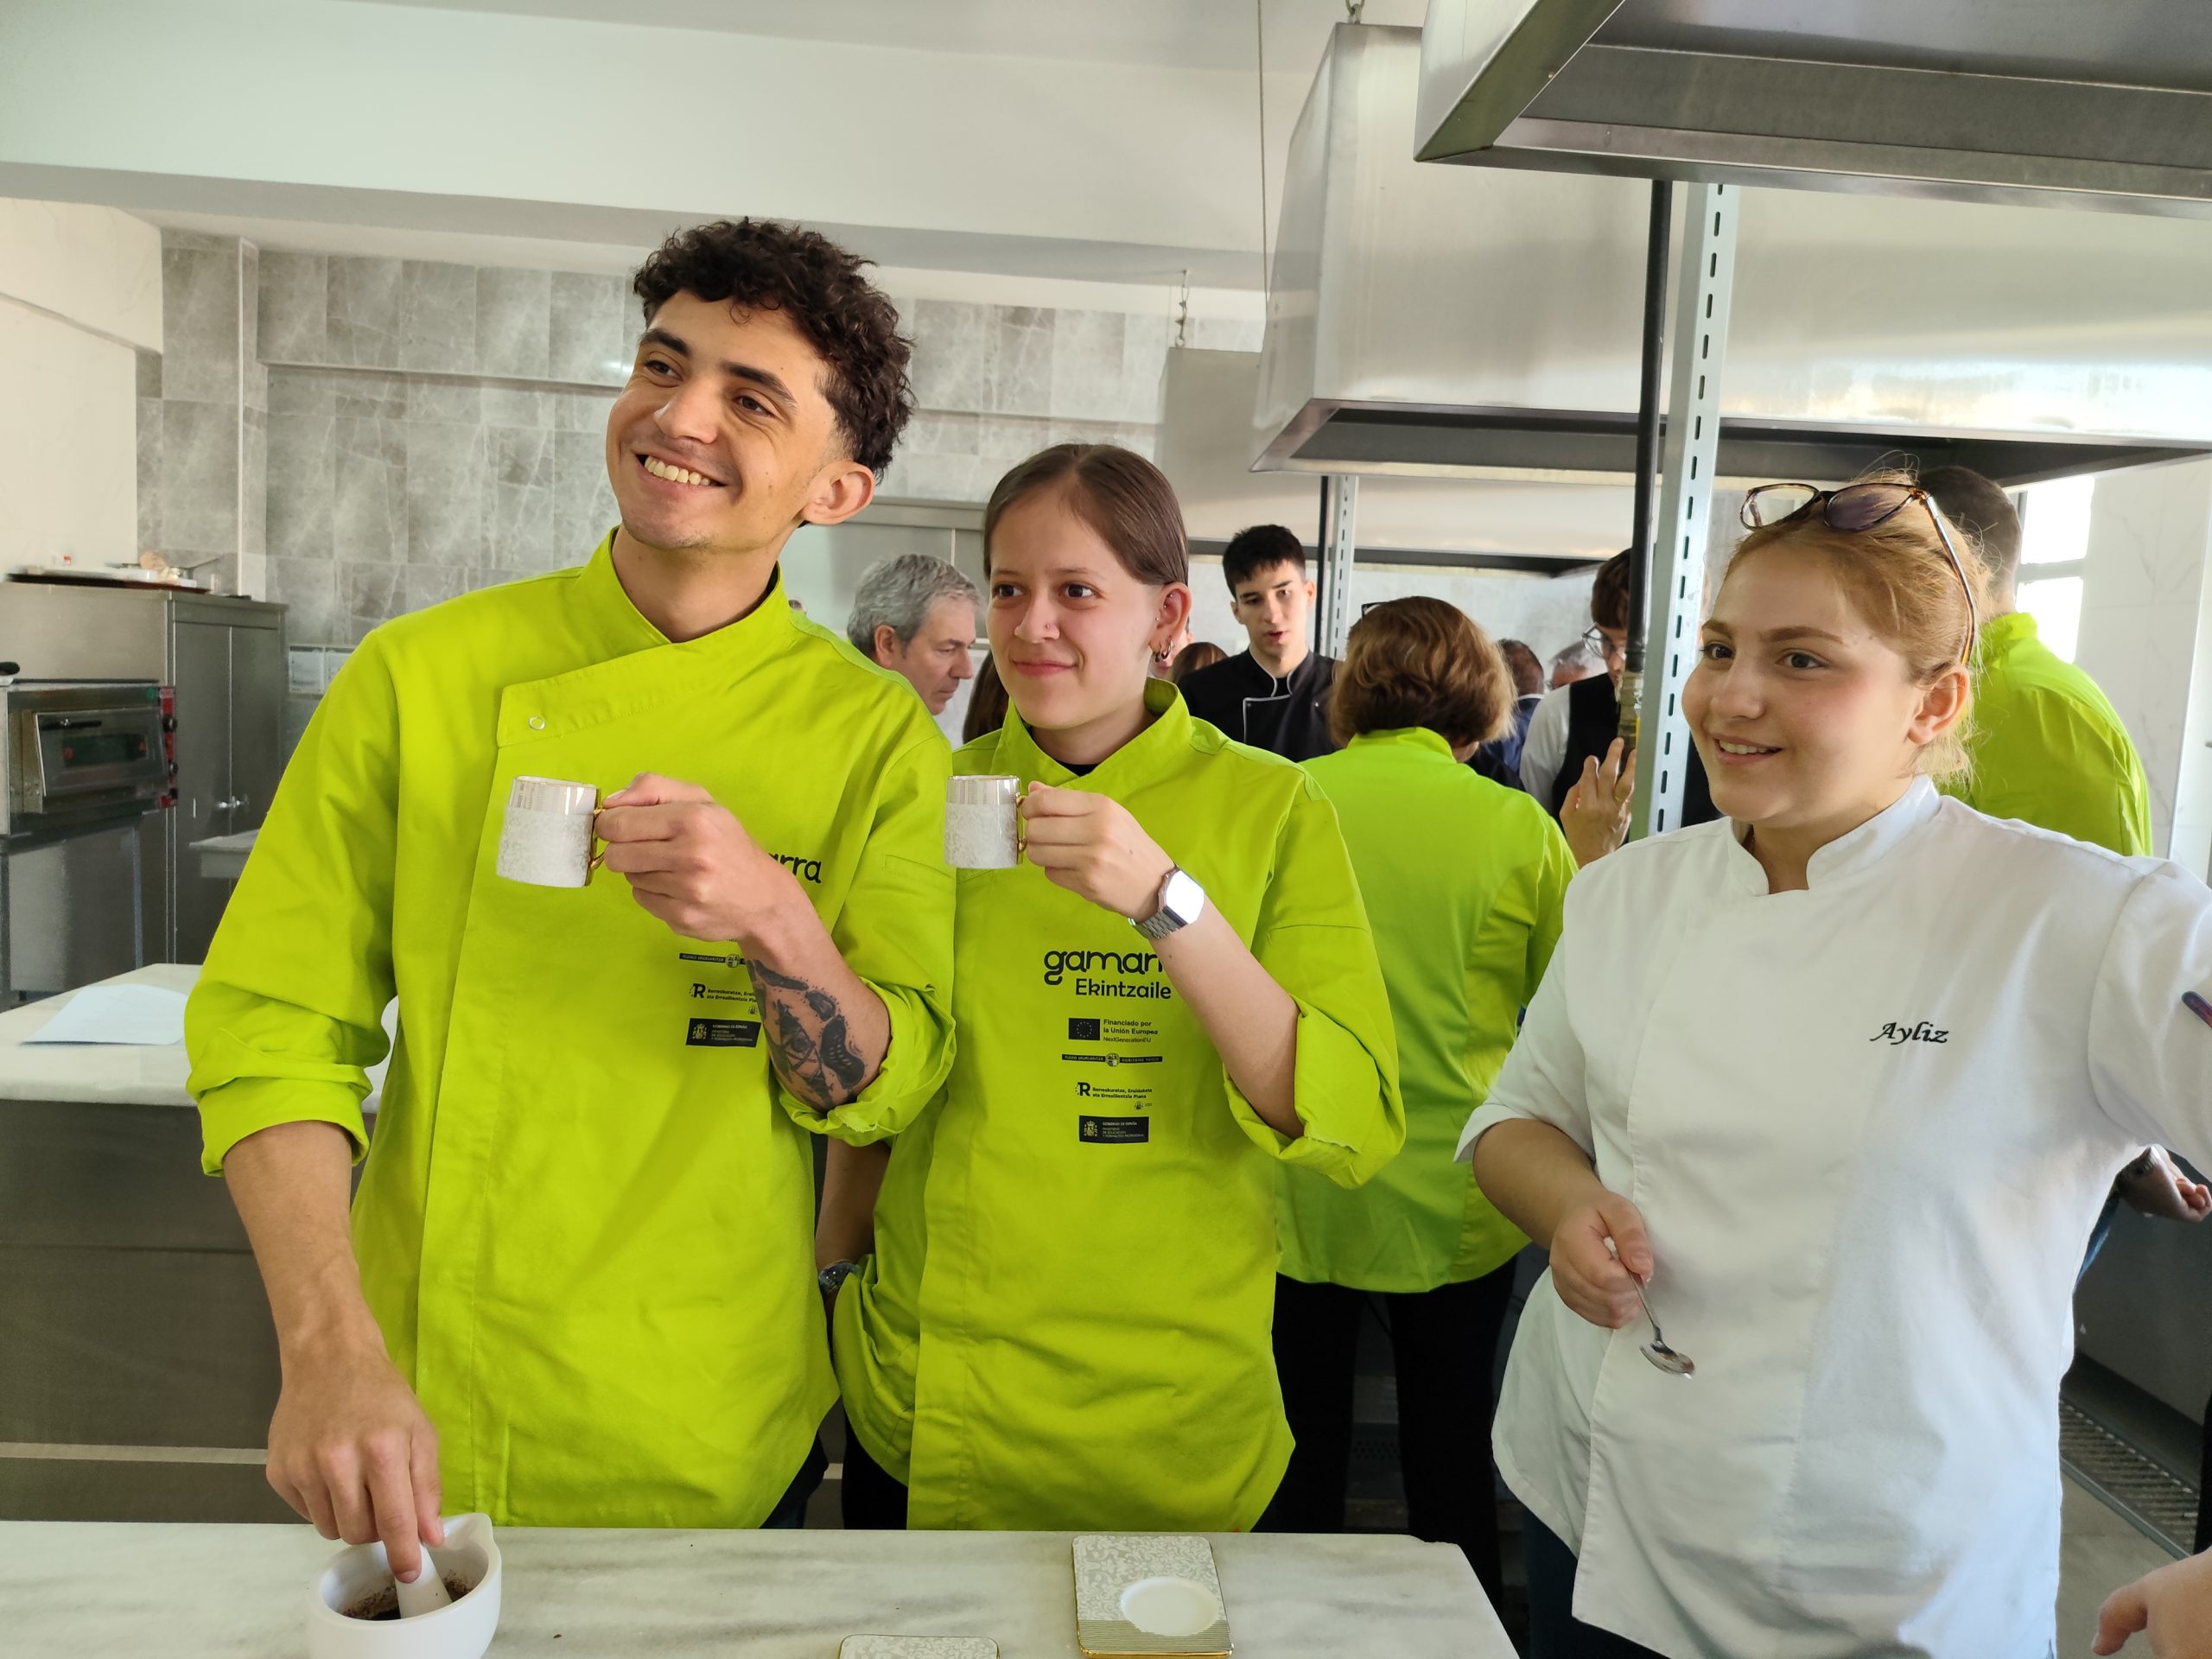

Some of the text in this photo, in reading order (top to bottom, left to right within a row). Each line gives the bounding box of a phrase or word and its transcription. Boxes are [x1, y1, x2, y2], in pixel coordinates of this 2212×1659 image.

[767, 853, 822, 884] rra
[1075, 978, 1172, 1000] Ekintzaile
[1869, 1021, 1949, 1046] Ayliz
